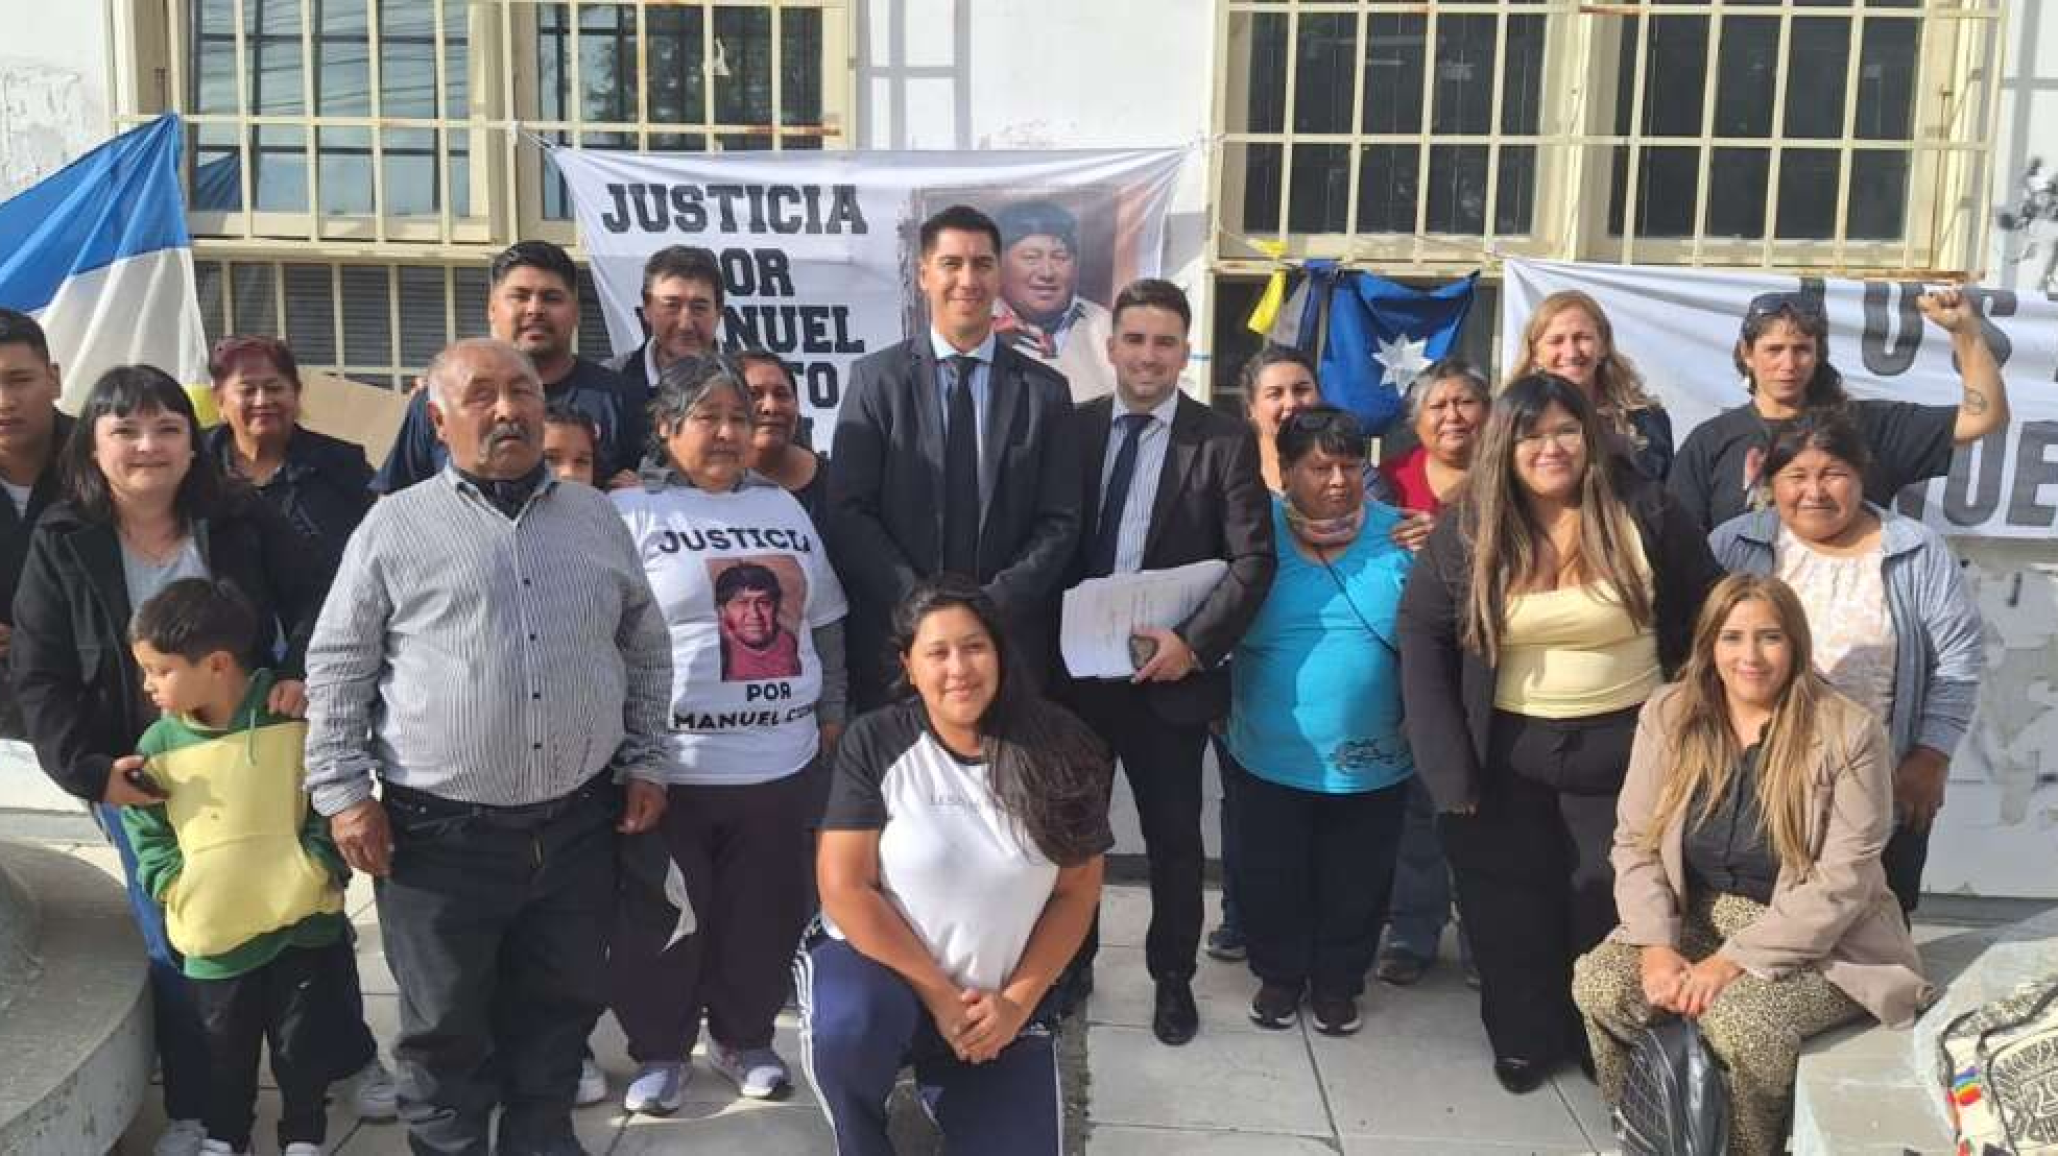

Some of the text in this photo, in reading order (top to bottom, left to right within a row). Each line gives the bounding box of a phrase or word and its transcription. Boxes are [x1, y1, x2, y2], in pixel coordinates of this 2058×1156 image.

[602, 183, 869, 235] JUSTICIA
[713, 247, 795, 297] OR
[634, 304, 865, 354] NUEL
[746, 682, 791, 702] POR
[674, 710, 780, 730] MANUEL
